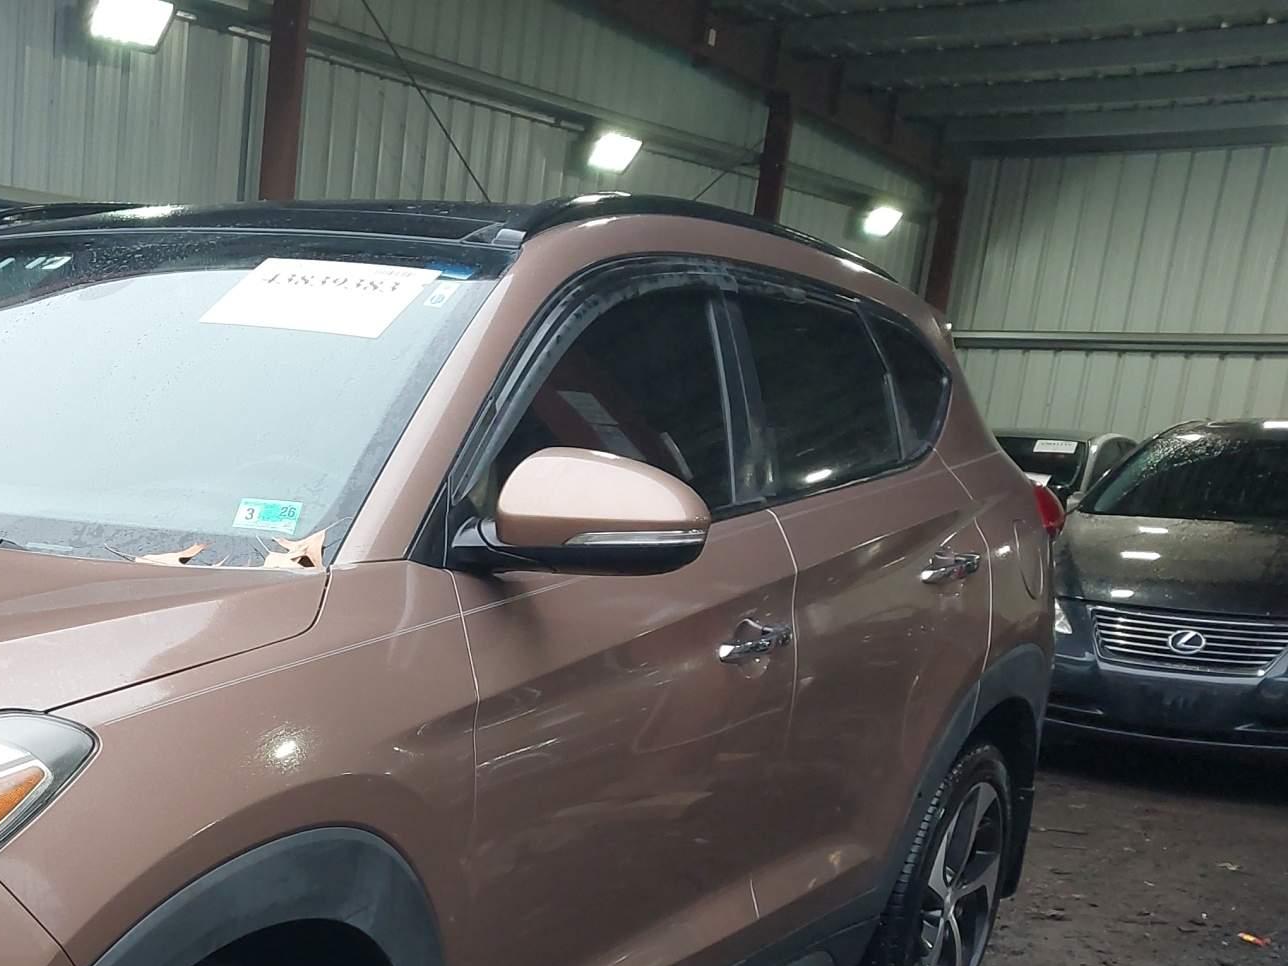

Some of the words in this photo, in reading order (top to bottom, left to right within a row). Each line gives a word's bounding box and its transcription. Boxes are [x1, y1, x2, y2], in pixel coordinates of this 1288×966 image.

[262, 272, 401, 292] 43839383
[245, 507, 255, 520] 3
[280, 506, 296, 518] 26
